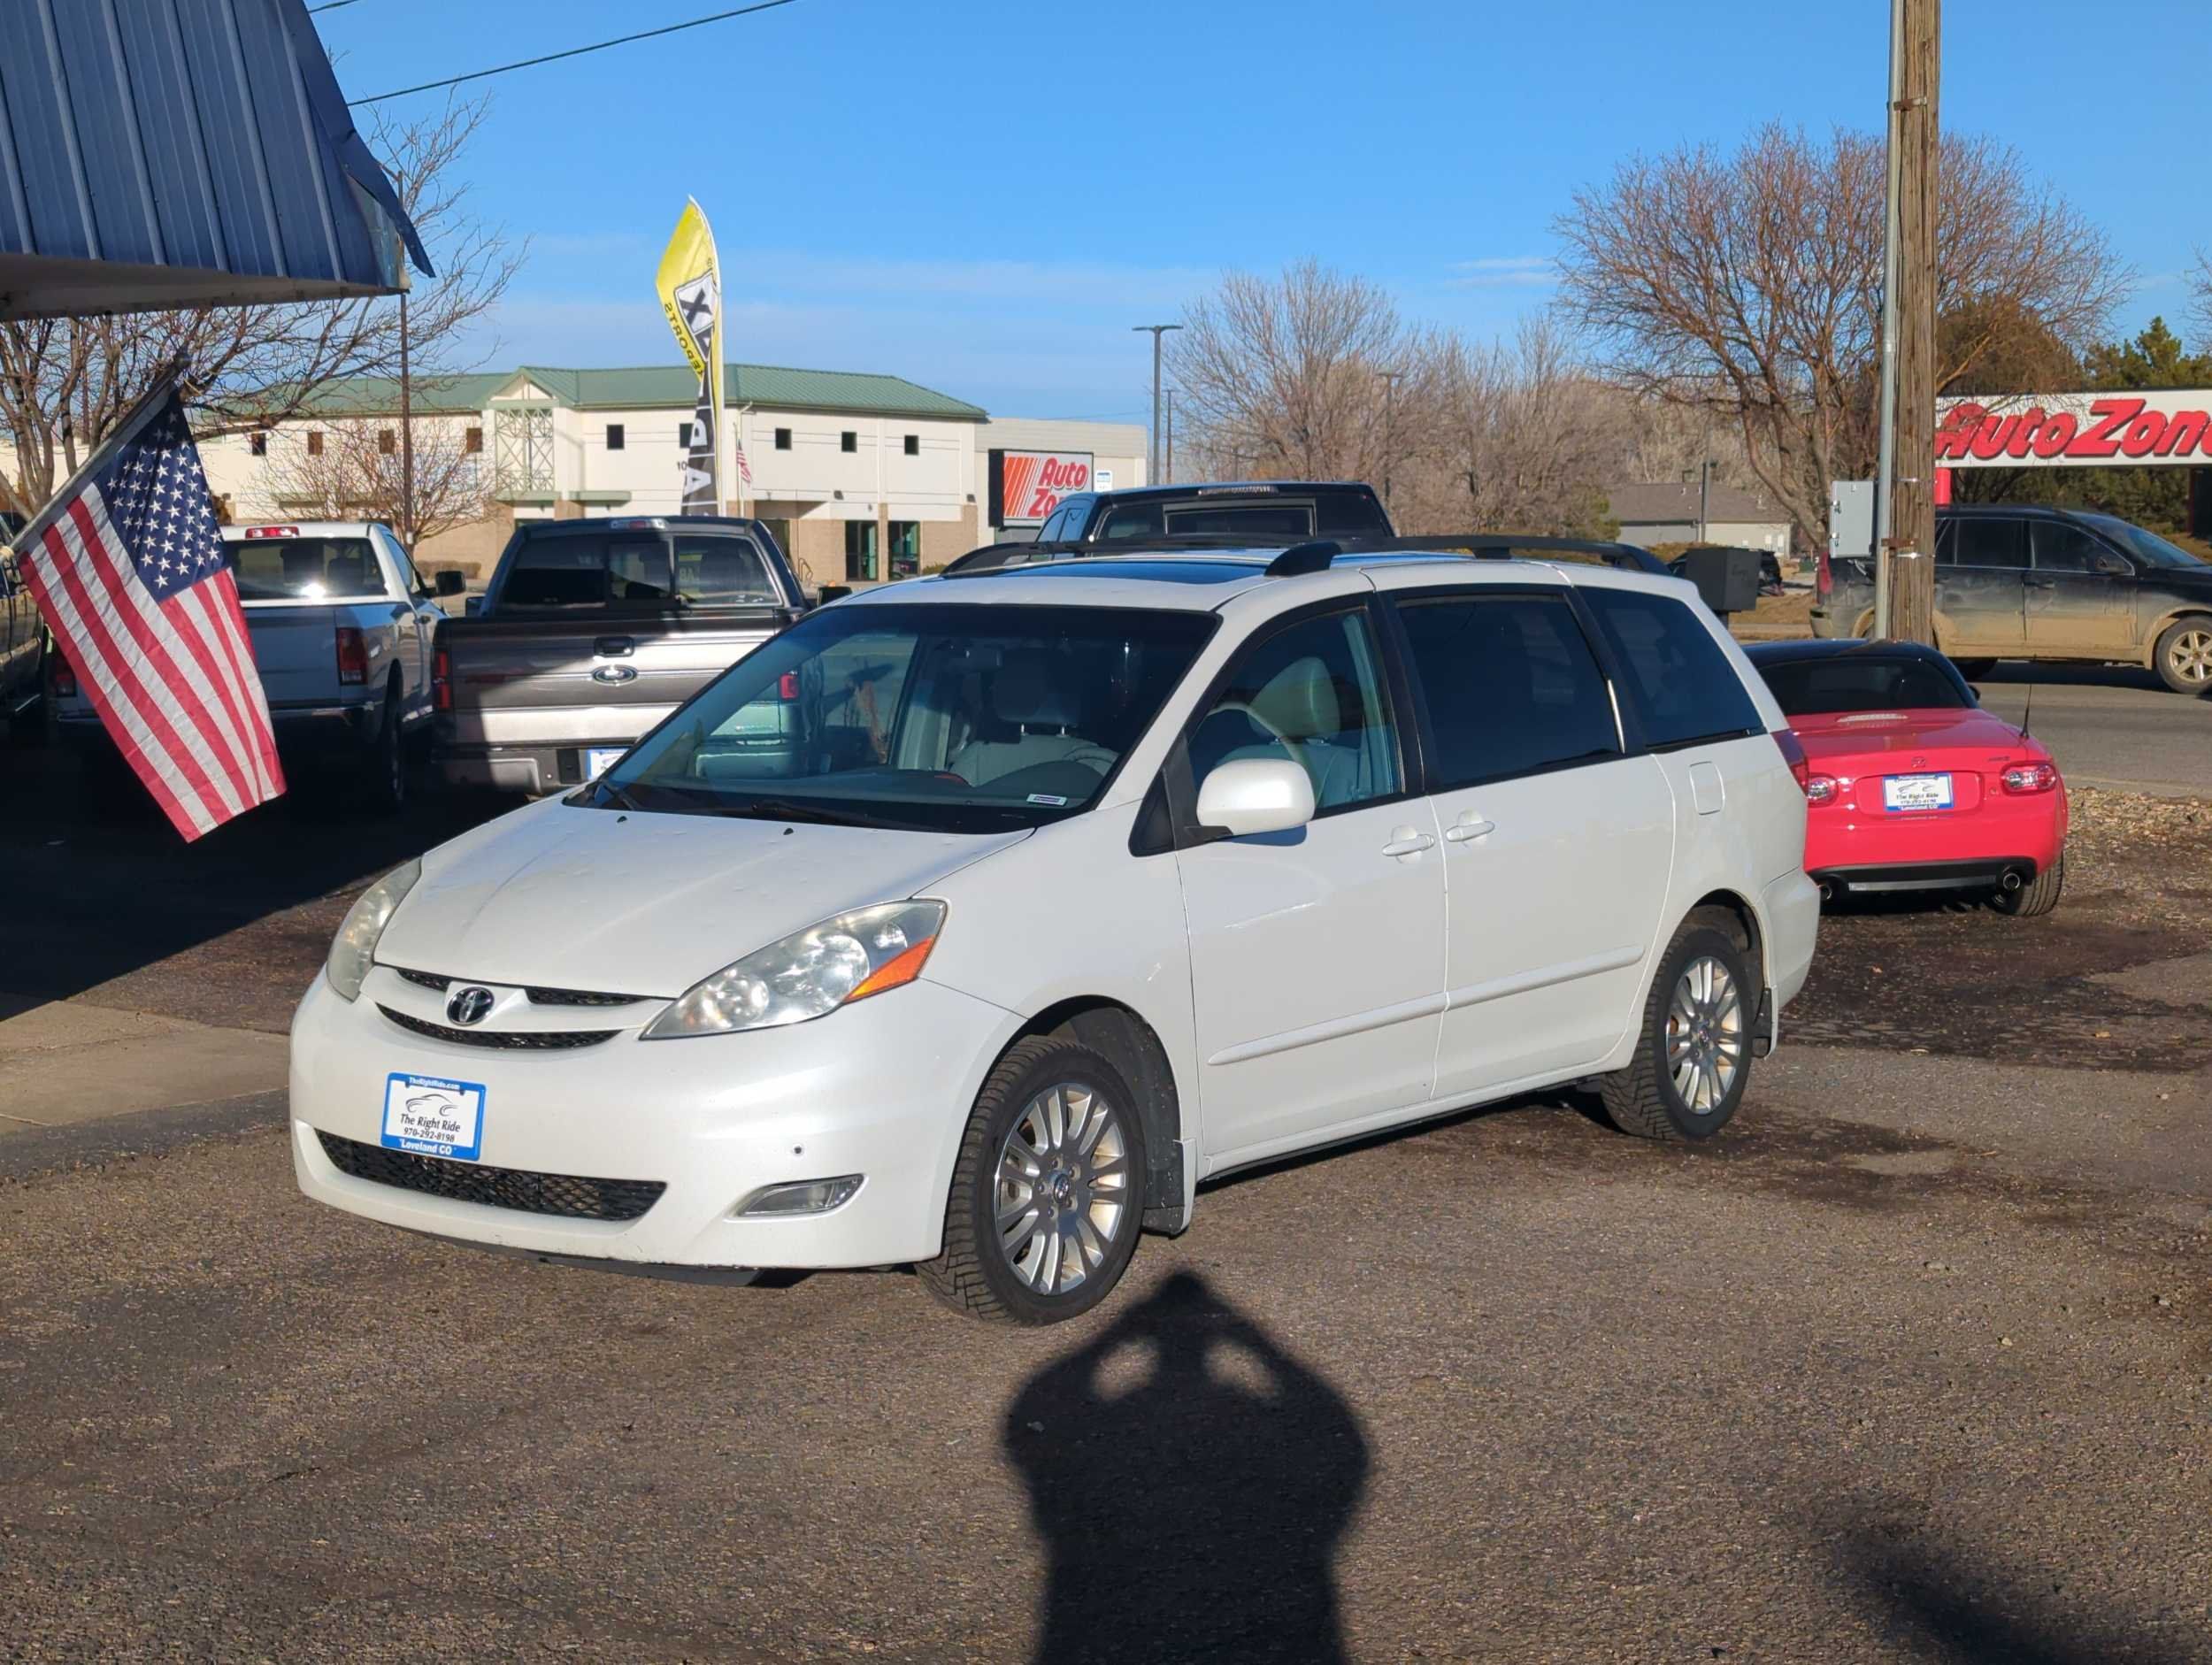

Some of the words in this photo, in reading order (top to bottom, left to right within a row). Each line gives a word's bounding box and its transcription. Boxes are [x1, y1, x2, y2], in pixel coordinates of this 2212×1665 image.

[1935, 398, 2212, 458] AutoZon
[1038, 457, 1088, 489] Auto
[400, 1113, 415, 1125] The
[417, 1116, 441, 1131] Right
[442, 1119, 461, 1132] Ride
[403, 1127, 456, 1143] 970-292-8198
[401, 1139, 438, 1154] Loveland
[439, 1145, 452, 1155] CO
